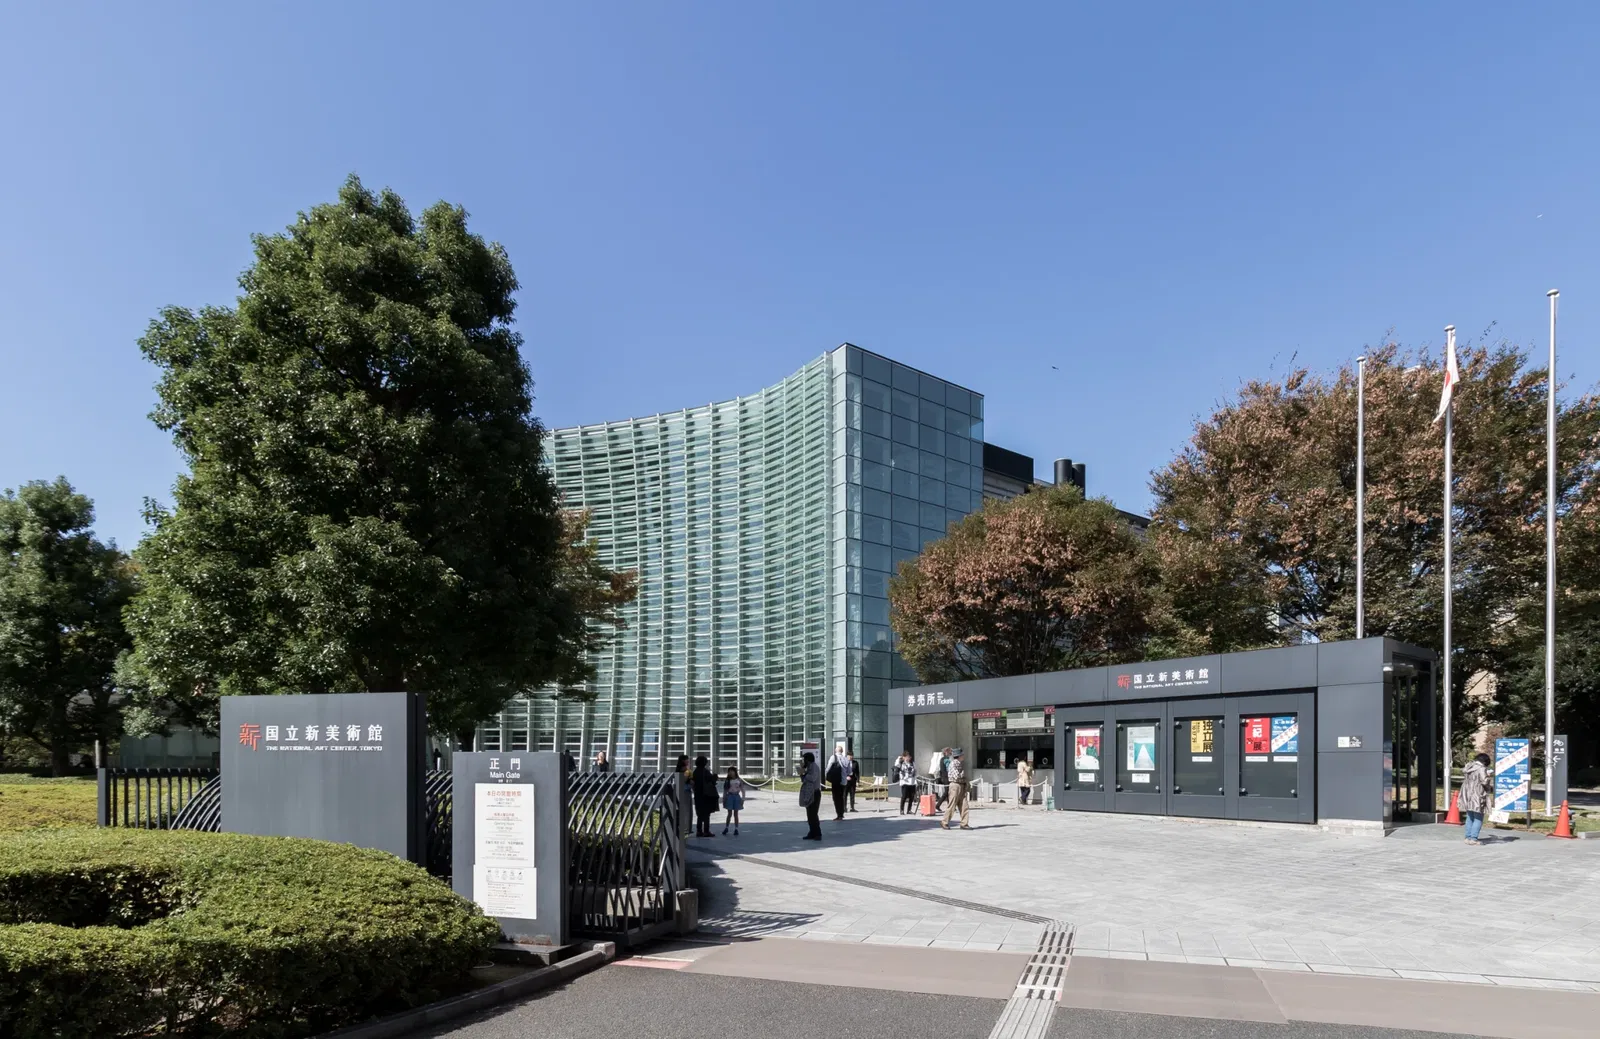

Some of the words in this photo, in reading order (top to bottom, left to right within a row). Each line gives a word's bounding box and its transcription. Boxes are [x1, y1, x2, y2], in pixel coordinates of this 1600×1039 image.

[1134, 668, 1209, 685] 国立新美術館
[908, 692, 935, 707] 券売所
[265, 724, 383, 742] 国立新美術館
[489, 757, 521, 770] 正門
[490, 771, 505, 779] Main
[505, 771, 521, 779] Gate
